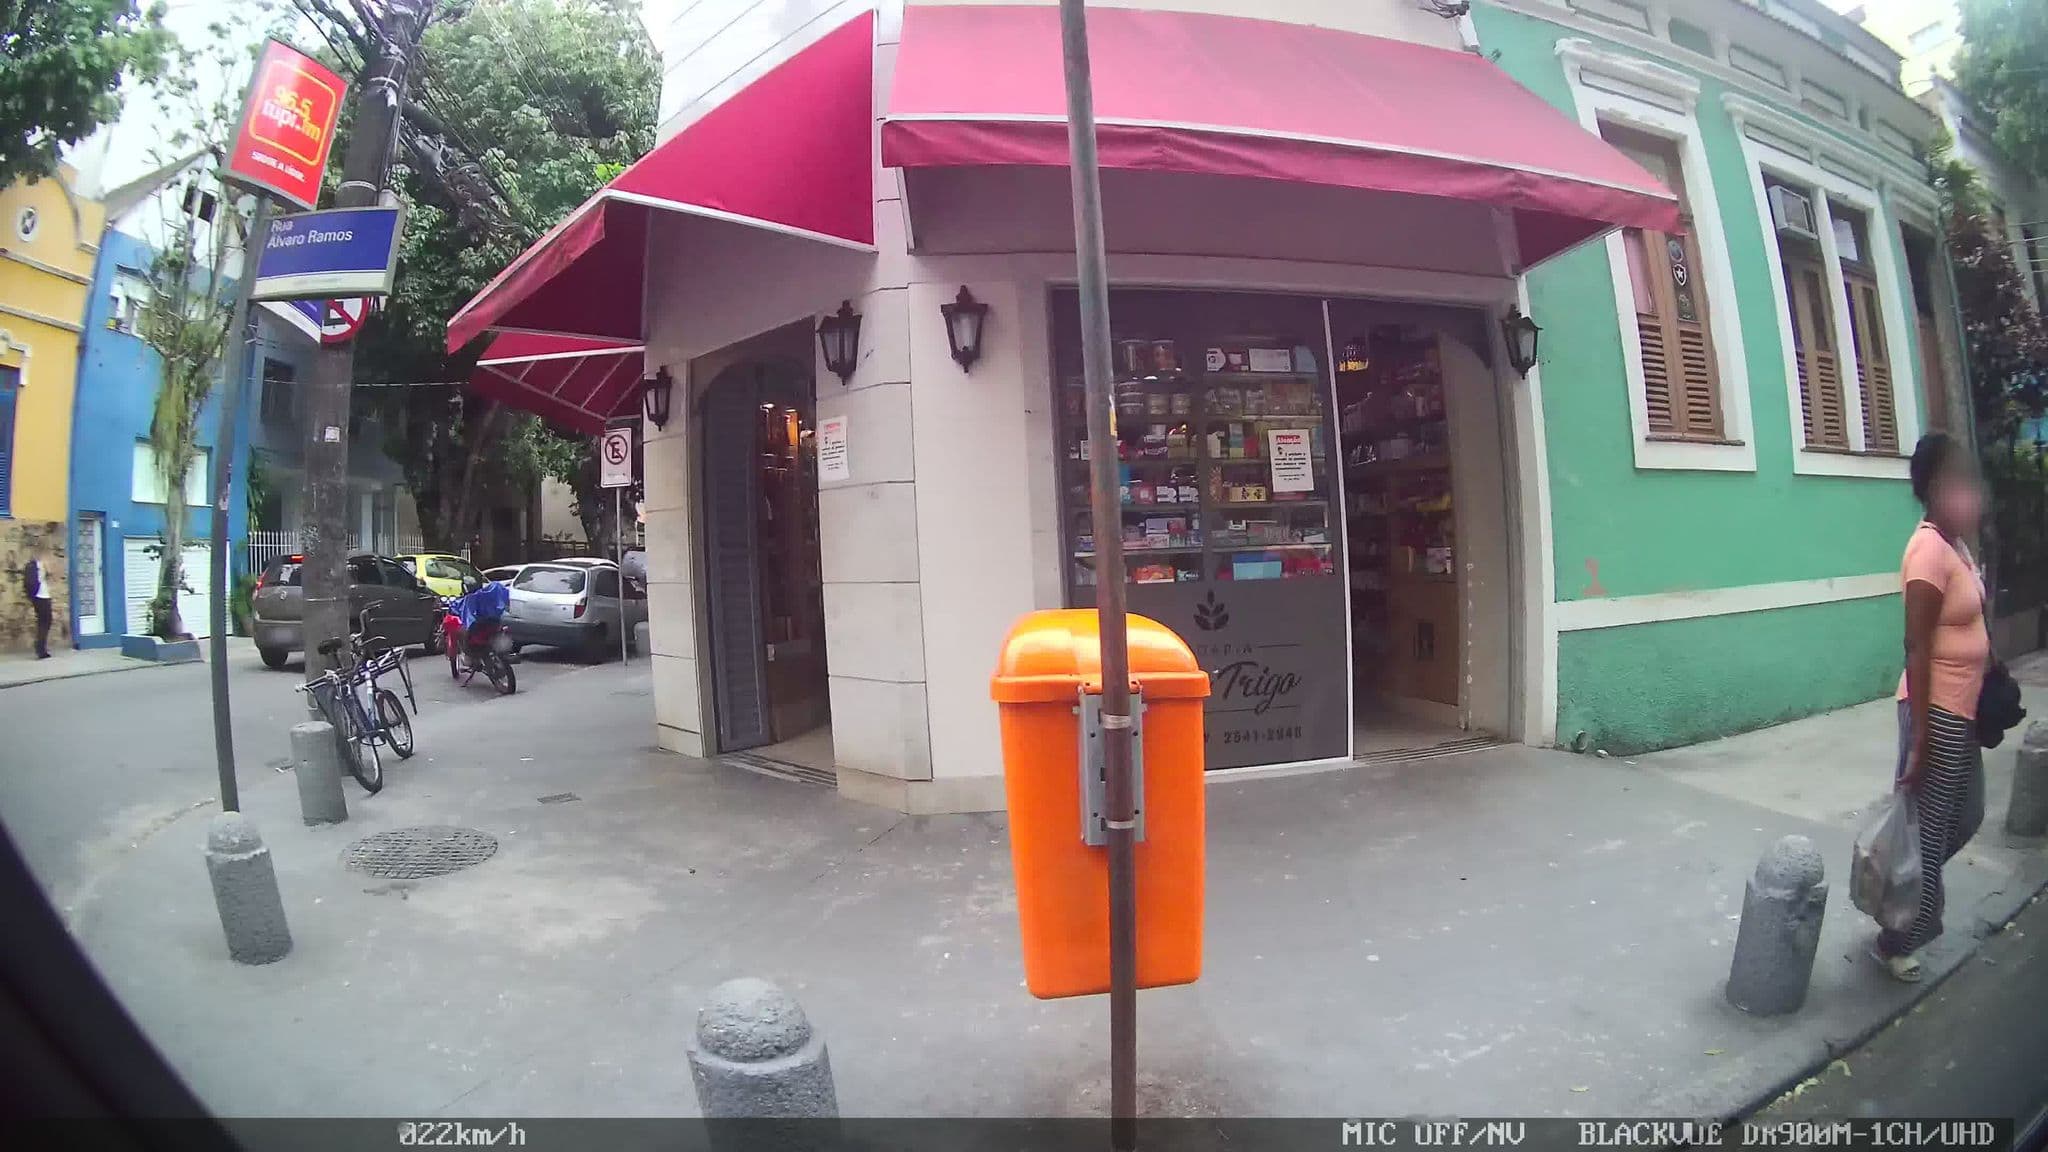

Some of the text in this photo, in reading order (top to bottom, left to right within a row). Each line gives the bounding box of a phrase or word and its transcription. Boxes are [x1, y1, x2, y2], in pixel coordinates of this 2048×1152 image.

[271, 219, 294, 232] Rua
[307, 230, 353, 244] Ramos
[1217, 660, 1302, 715] Trigo
